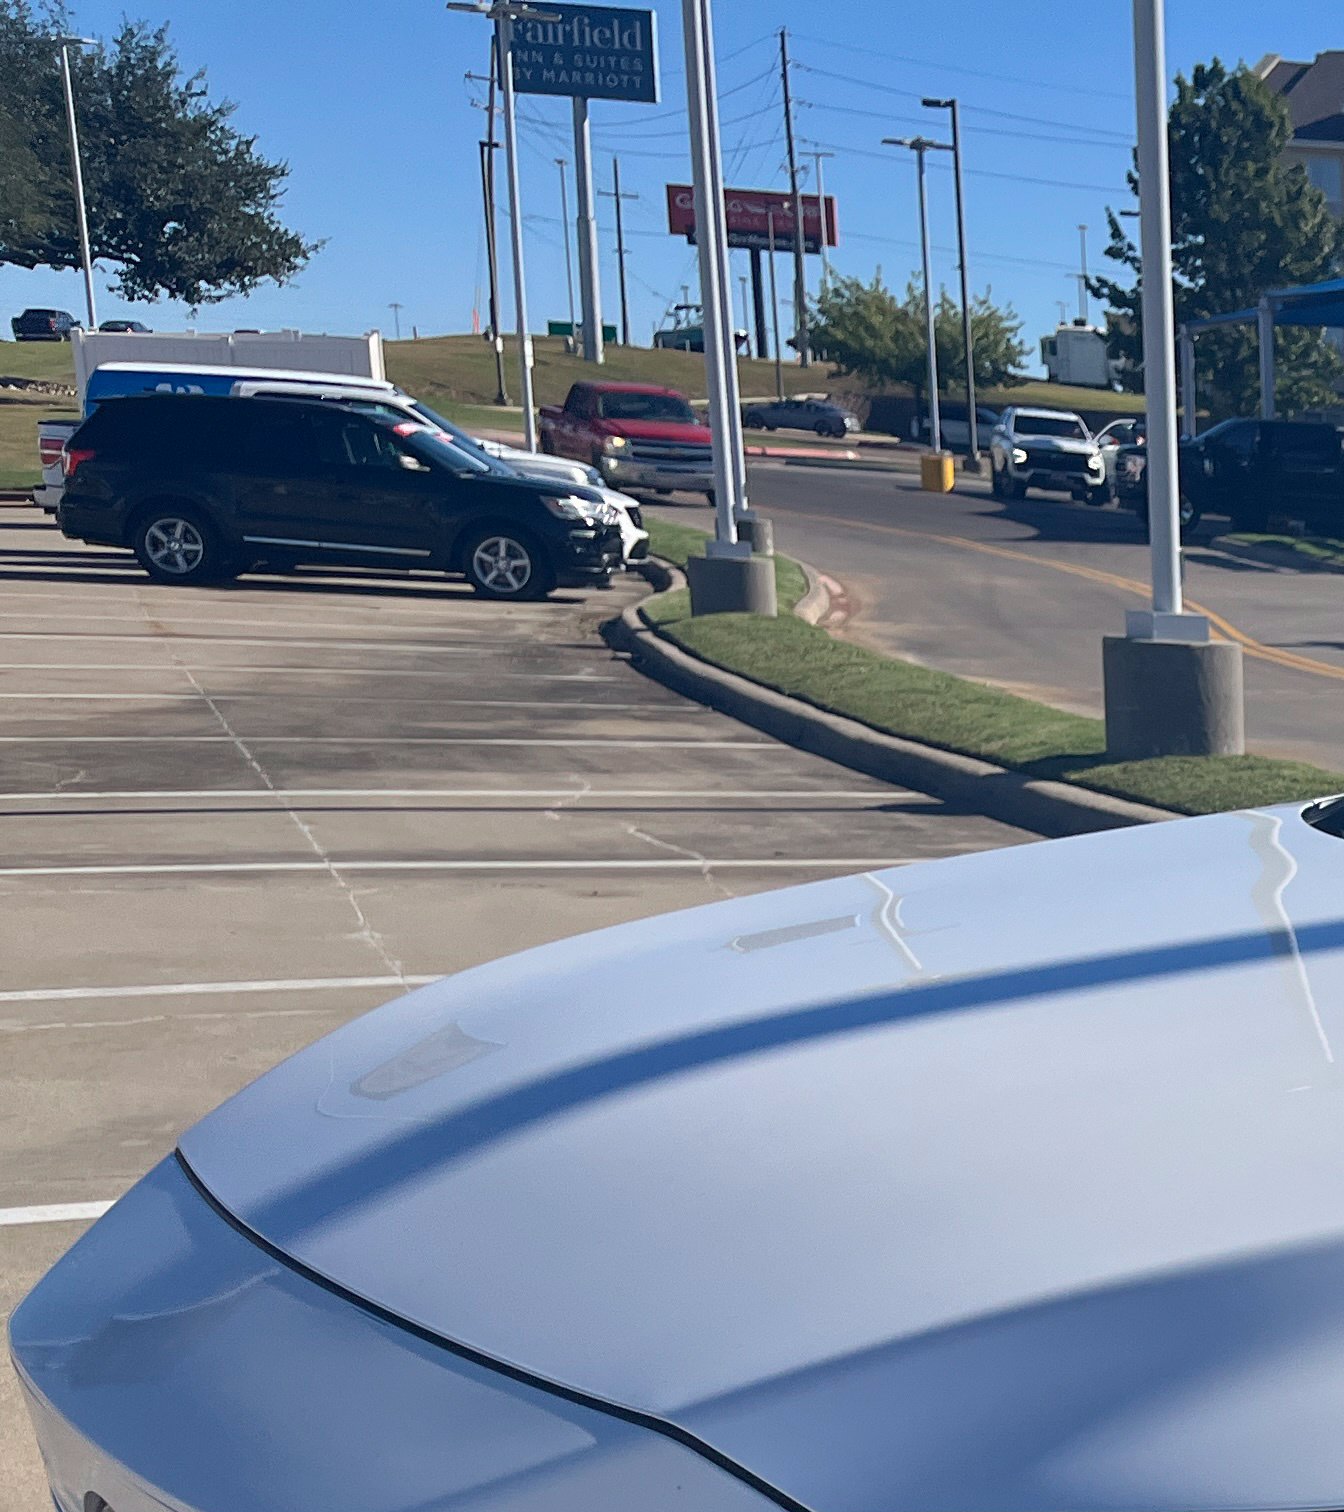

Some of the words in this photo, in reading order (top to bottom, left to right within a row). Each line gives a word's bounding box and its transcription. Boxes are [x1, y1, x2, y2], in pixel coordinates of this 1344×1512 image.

[515, 48, 544, 63] NN
[553, 52, 564, 65] &
[573, 54, 644, 73] SUITES
[543, 68, 642, 88] MARRIOTT
